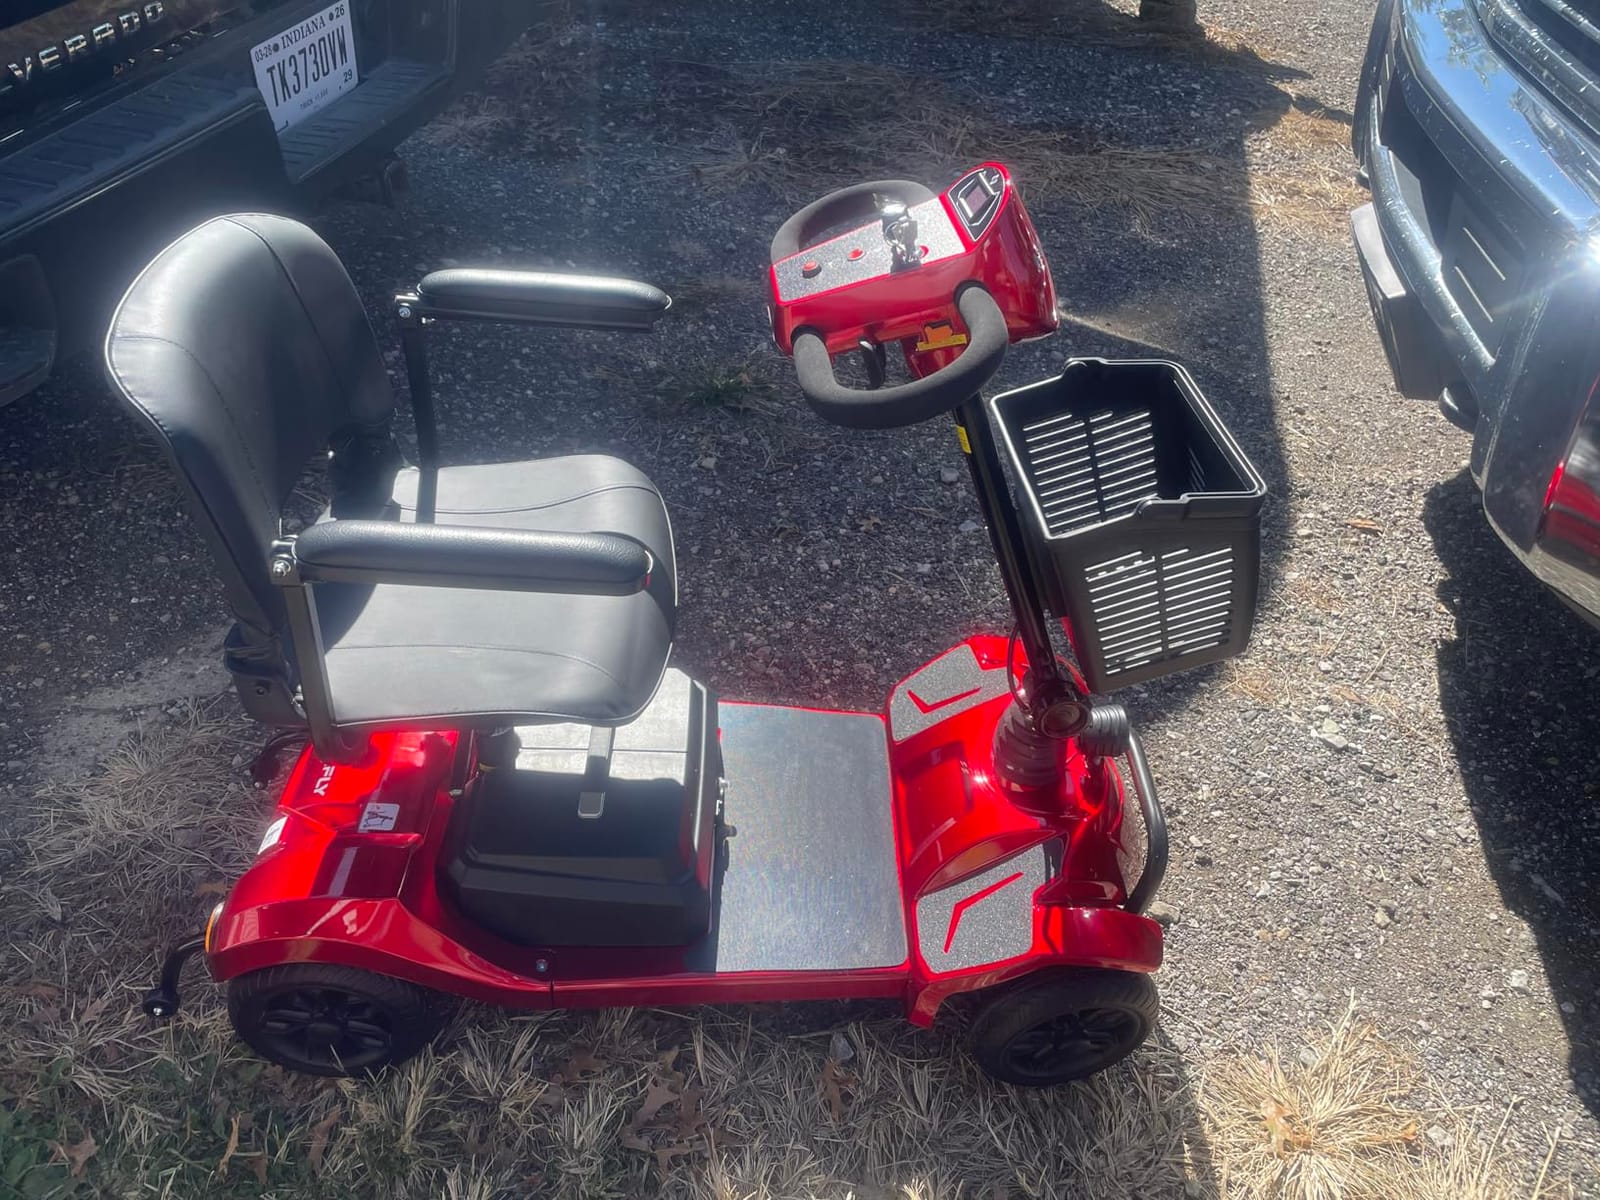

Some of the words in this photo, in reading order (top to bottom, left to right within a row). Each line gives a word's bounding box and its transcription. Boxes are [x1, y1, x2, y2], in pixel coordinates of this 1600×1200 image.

[0, 1, 164, 92] VERADO
[280, 15, 326, 50] INDIANA
[334, 4, 345, 19] 26
[343, 68, 353, 83] 29
[312, 763, 336, 797] FLY
